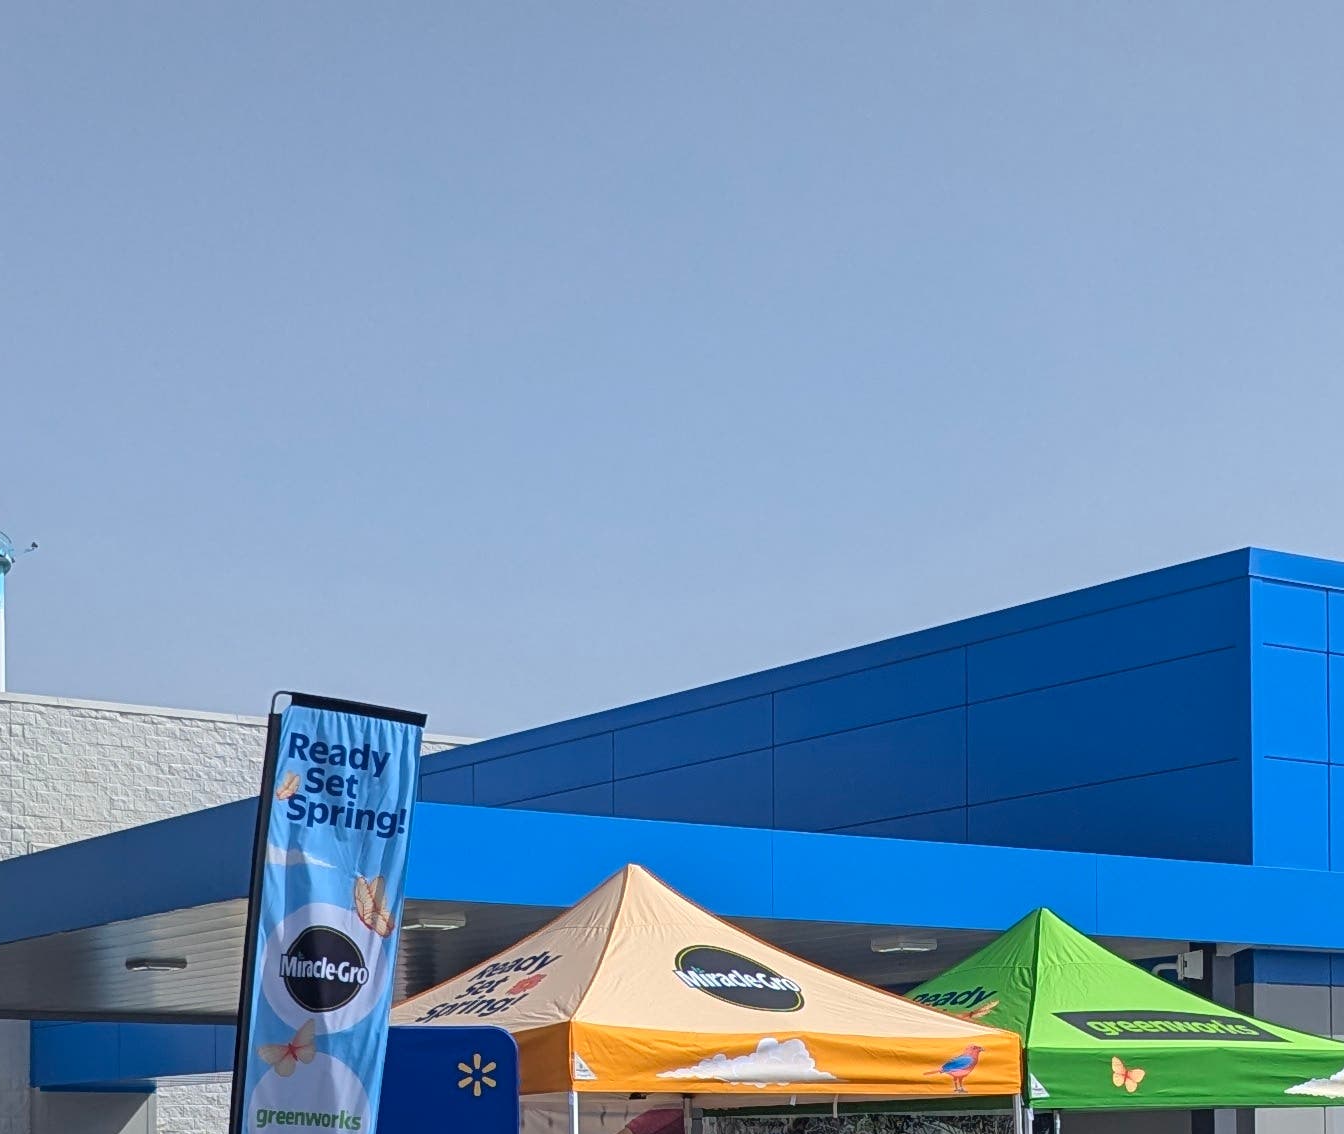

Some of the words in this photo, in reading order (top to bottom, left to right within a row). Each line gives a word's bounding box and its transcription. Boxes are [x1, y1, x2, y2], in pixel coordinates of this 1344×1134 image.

[287, 732, 392, 778] Ready
[305, 767, 359, 800] Set
[285, 794, 408, 839] Spring!
[280, 954, 369, 985] Miracle-Gro
[467, 950, 563, 982] Ready
[674, 969, 801, 992] Miracle-Gro
[455, 975, 509, 999] Set
[414, 993, 529, 1023] Spring!
[1085, 1018, 1261, 1036] greenworks
[255, 1108, 362, 1131] greenworks
